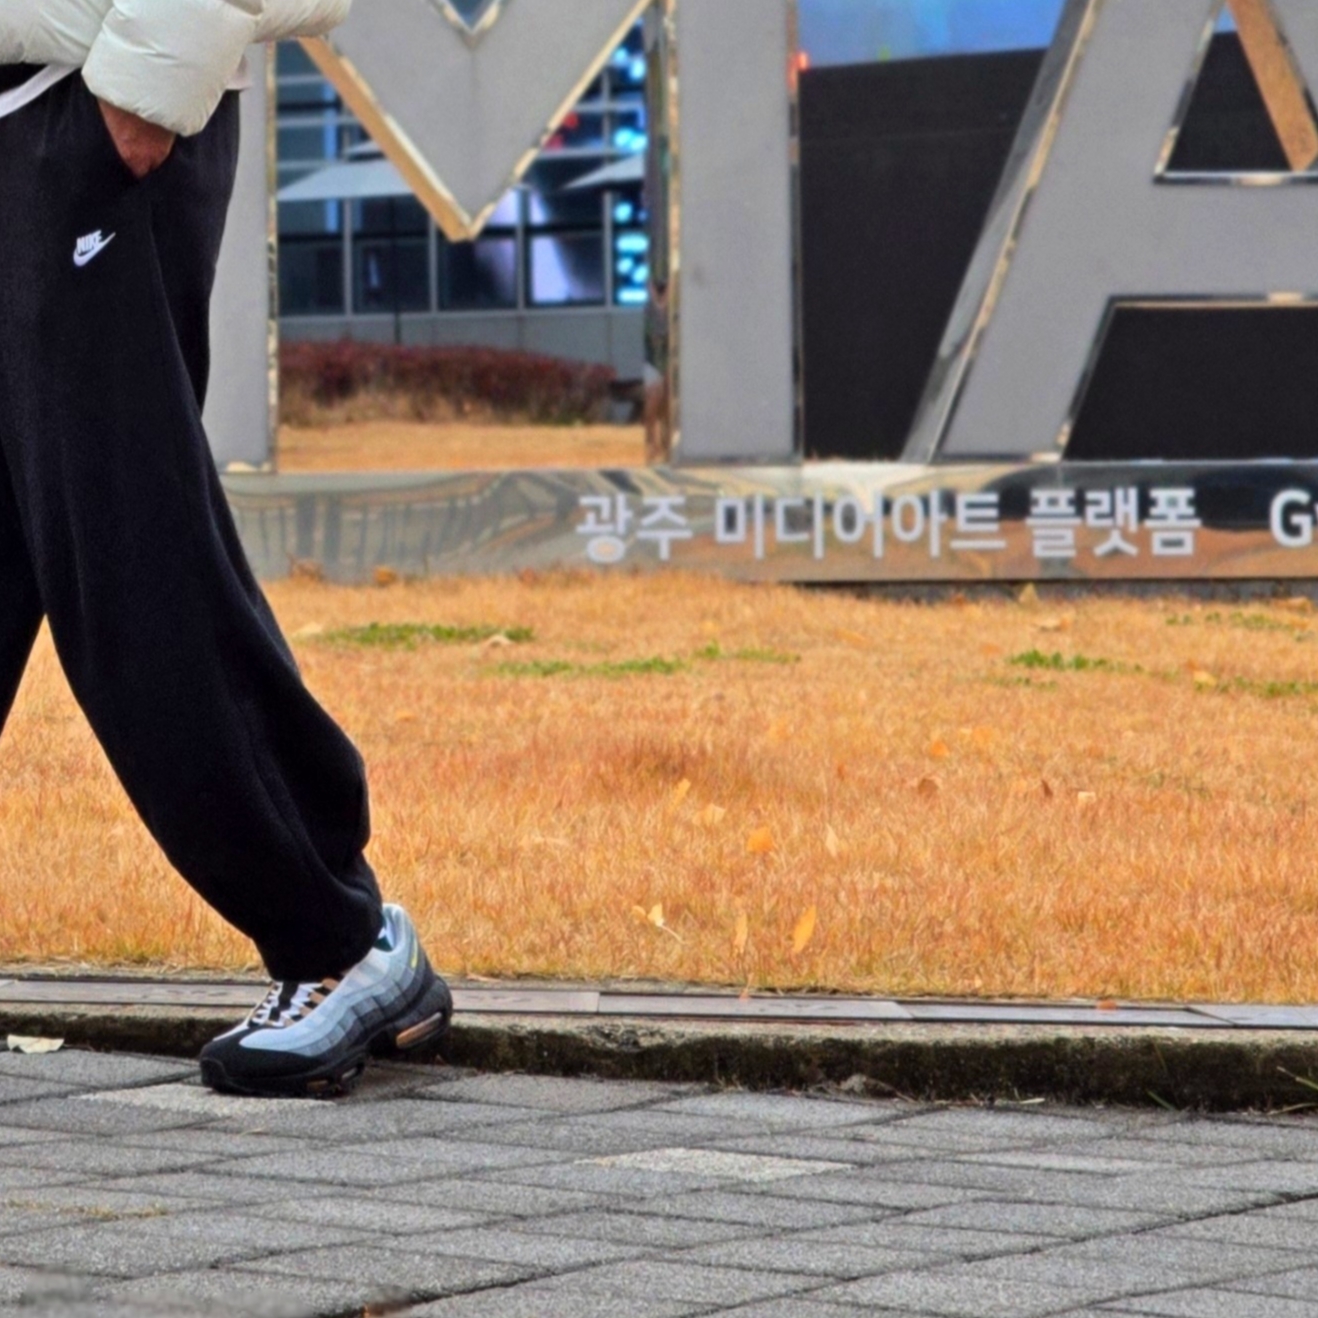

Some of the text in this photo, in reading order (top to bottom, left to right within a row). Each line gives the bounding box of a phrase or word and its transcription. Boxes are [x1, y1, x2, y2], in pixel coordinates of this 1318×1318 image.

[76, 229, 103, 255] NIKE
[577, 486, 1318, 563] 광주 미디어아트 플랫폼 G
